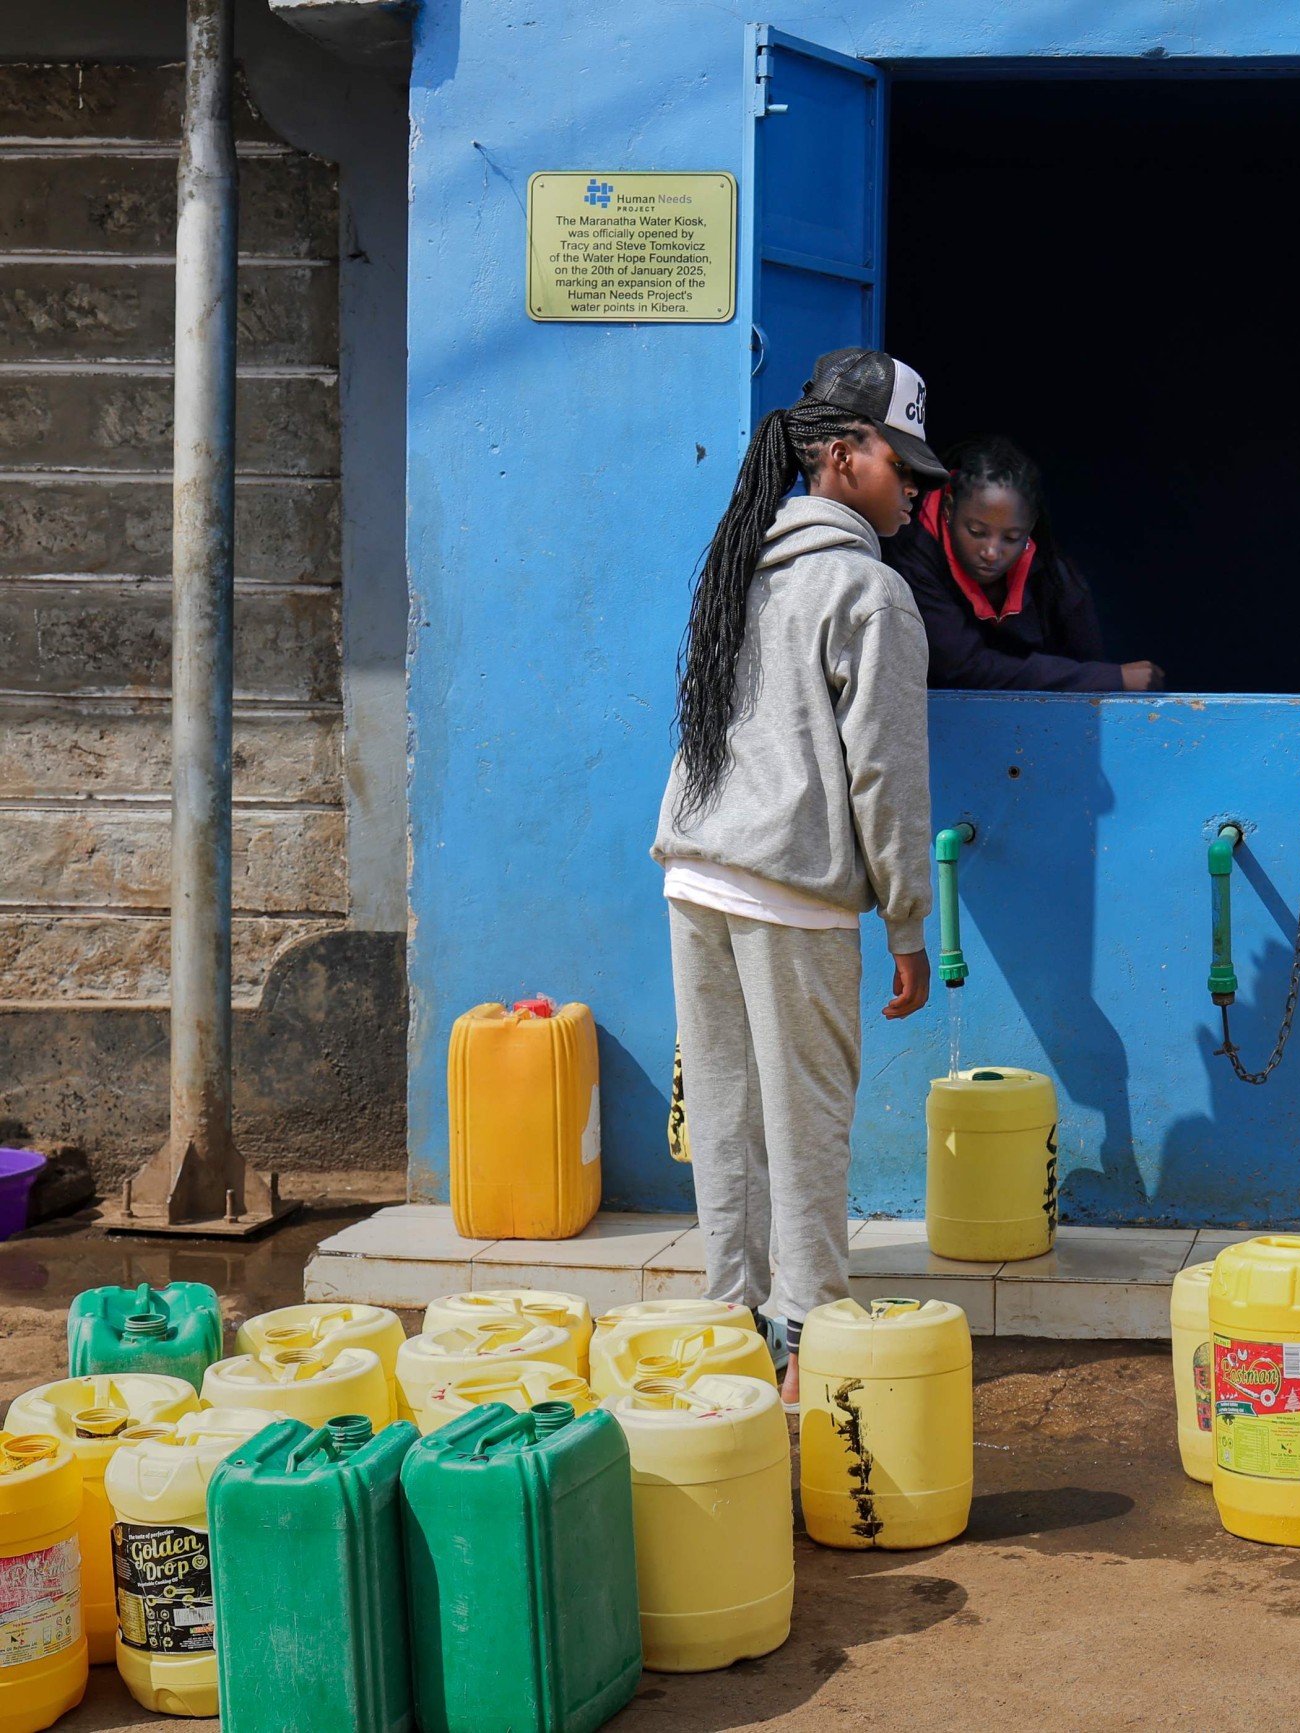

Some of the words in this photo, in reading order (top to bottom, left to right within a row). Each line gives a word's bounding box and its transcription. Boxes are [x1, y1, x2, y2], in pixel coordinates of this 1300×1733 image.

[617, 195, 655, 204] Human
[658, 195, 692, 204] Needs
[556, 216, 576, 226] The
[580, 217, 636, 226] Maranatha
[640, 217, 671, 226] Water
[675, 217, 706, 227] Kiosk,
[592, 229, 634, 240] officially
[638, 229, 678, 240] opened
[682, 229, 694, 240] by
[561, 241, 589, 252] Tracy
[593, 241, 612, 250] and
[616, 241, 646, 250] Steve
[650, 241, 704, 250] Tomkovicz
[550, 254, 560, 262] of
[563, 254, 579, 262] the
[583, 254, 614, 262] Water
[618, 254, 645, 265] Hope
[650, 254, 712, 264] Foundation,
[572, 266, 587, 274] the
[591, 266, 614, 274] 20th
[618, 266, 628, 275] of
[631, 266, 673, 277] January
[677, 266, 706, 276] 2025,
[556, 278, 597, 289] marking
[618, 278, 671, 289] expansion
[675, 278, 686, 287] of
[689, 278, 705, 287] the
[568, 290, 606, 299] Human
[610, 291, 644, 299] Needs
[648, 291, 692, 302] Project's
[604, 303, 634, 314] points
[639, 303, 647, 312] in
[651, 303, 688, 312] Kibera.
[1222, 1358, 1278, 1384] Postman
[151, 1530, 174, 1538] perfection
[131, 1535, 204, 1570] Golden
[142, 1560, 189, 1581] Drop
